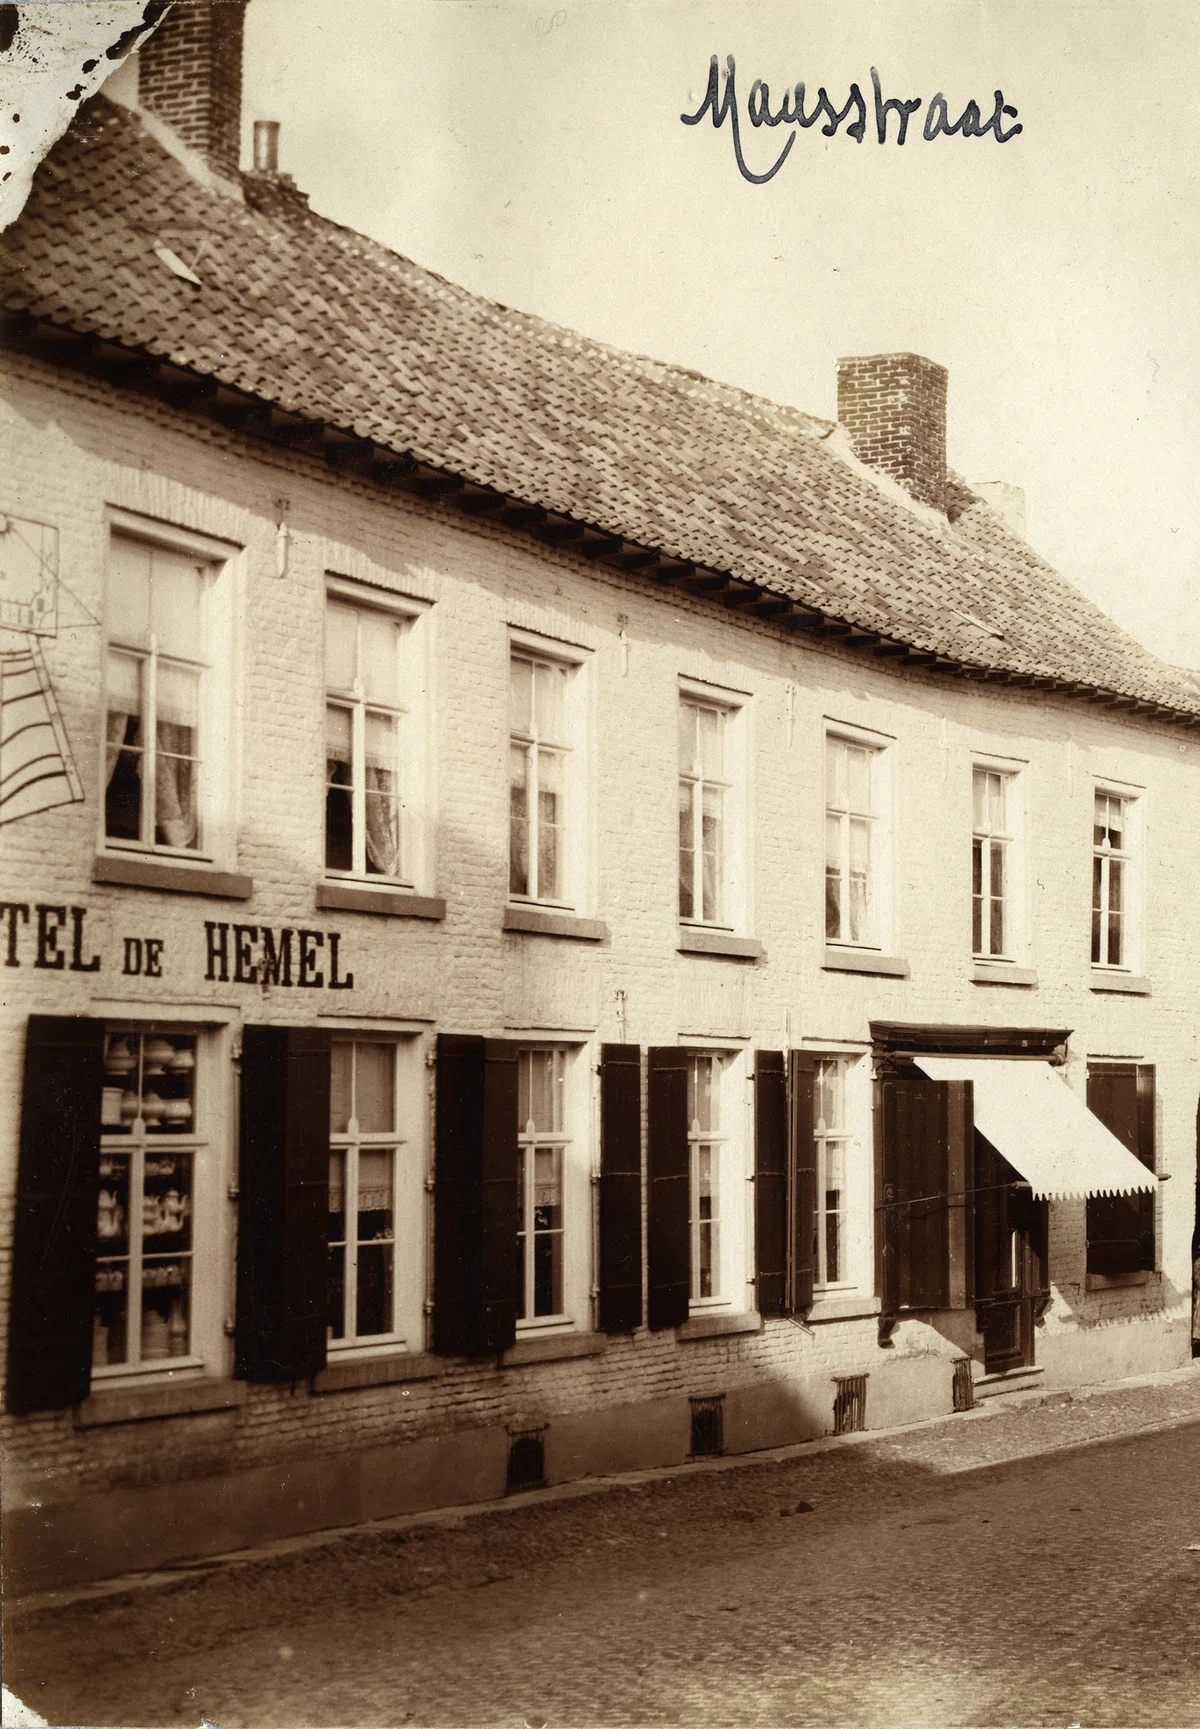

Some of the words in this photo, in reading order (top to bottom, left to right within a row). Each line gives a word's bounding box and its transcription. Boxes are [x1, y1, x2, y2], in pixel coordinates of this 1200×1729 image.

[0, 902, 101, 972] TEL
[122, 938, 164, 977] DE
[204, 921, 354, 989] HEMEL
